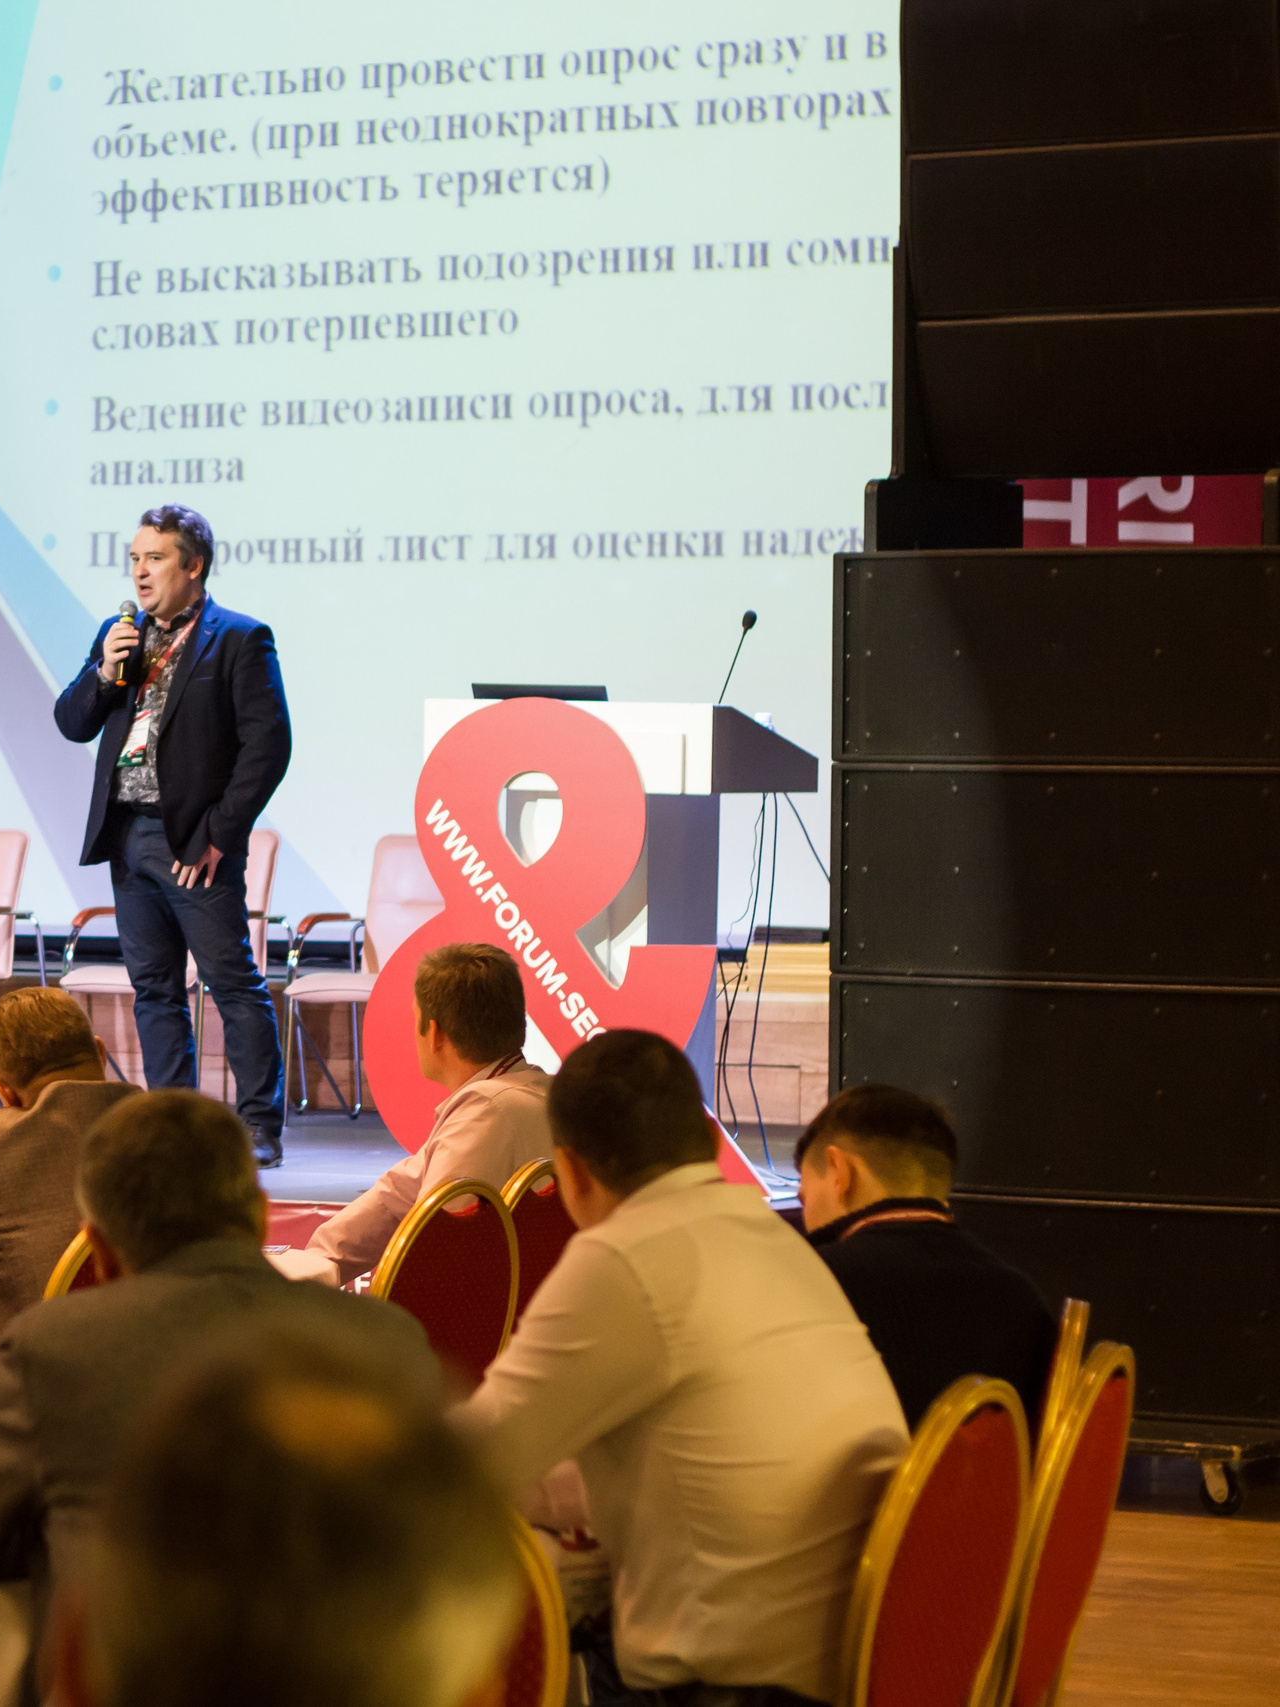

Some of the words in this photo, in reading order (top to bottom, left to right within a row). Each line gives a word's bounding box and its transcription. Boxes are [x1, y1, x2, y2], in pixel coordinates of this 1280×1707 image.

[104, 67, 346, 106] Желательно
[360, 52, 545, 98] провести
[561, 44, 680, 84] опрос
[695, 34, 807, 78] сразу
[824, 33, 848, 61] и
[865, 31, 888, 59] в
[92, 124, 238, 160] объеме.
[251, 116, 341, 160] (при
[355, 100, 680, 147] неоднократных
[695, 87, 892, 130] повторах
[92, 174, 400, 225] эффективность
[414, 156, 610, 208] теряется)
[93, 259, 143, 298] Не
[156, 257, 421, 294] высказывать
[437, 244, 675, 288] подозрения
[692, 241, 770, 271] или
[785, 235, 892, 267] сомн
[92, 319, 220, 351] словах
[234, 307, 520, 352] потерпевшего
[91, 396, 247, 433] Ведение
[261, 392, 514, 427] видеозаписи
[528, 387, 685, 428] опроса,
[696, 384, 775, 417] для
[89, 455, 246, 487] анализа
[377, 533, 474, 563] лист
[484, 532, 559, 562] для
[572, 530, 725, 563] оценки
